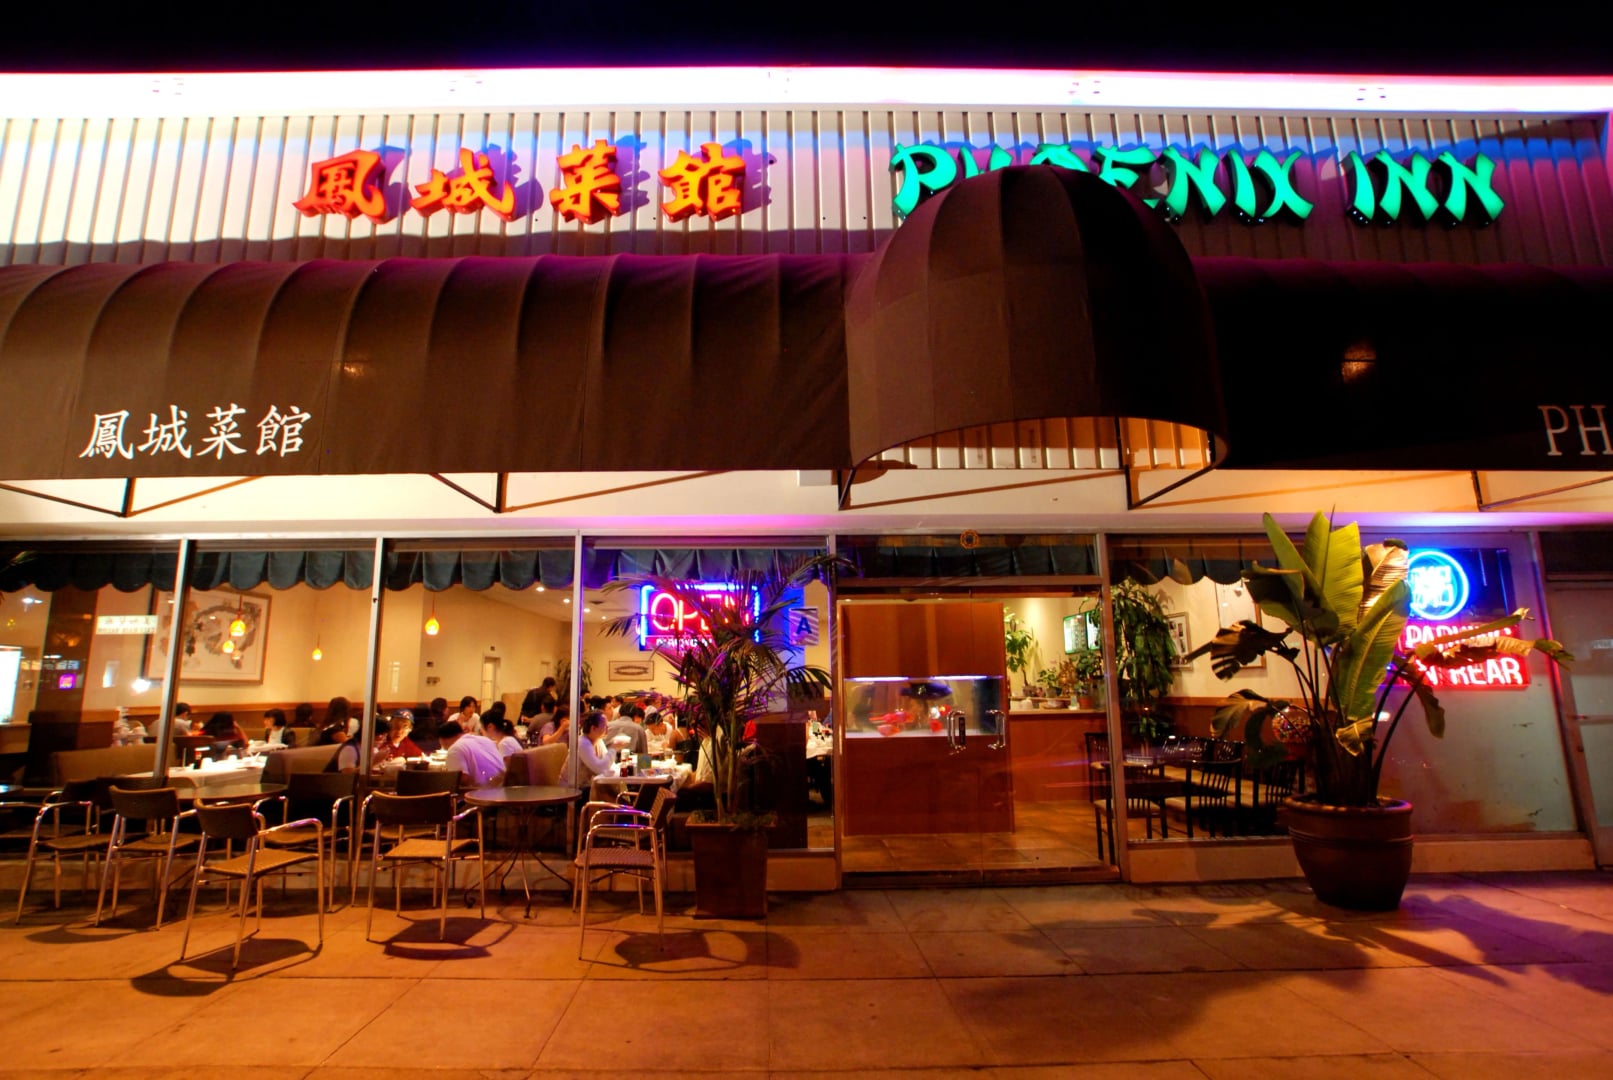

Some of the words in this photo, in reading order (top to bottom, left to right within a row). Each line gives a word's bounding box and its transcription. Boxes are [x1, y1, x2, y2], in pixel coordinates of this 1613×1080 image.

[293, 139, 747, 225] 鳳城菜館
[1348, 150, 1505, 221] INN
[78, 403, 312, 460] 鳳城菜館
[796, 616, 812, 634] A
[1448, 656, 1524, 686] REAR
